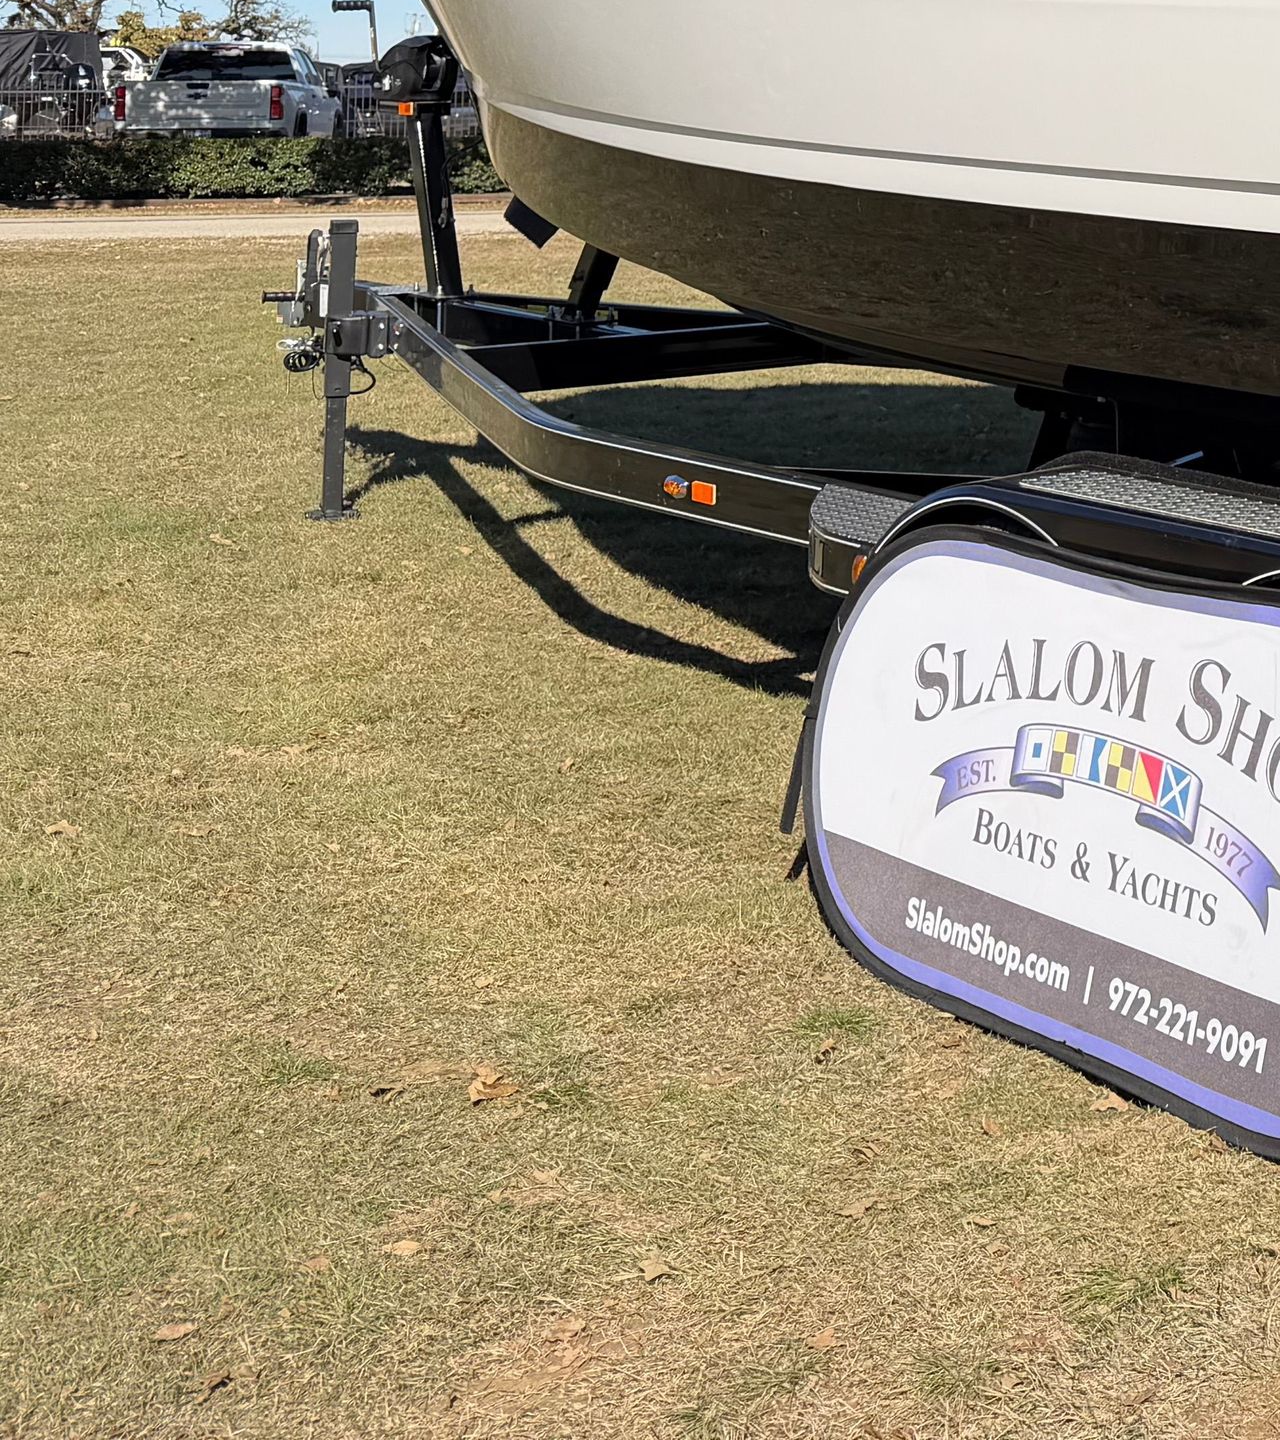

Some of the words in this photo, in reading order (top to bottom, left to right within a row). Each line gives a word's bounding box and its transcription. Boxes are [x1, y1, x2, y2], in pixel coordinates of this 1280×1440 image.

[914, 638, 1155, 723] SLALOM
[956, 759, 997, 792] EST.
[972, 808, 1057, 870] BOATS
[1071, 843, 1092, 884] &
[1107, 852, 1219, 927] YACHTS
[1203, 826, 1254, 878] 1977
[905, 897, 1070, 992] SlalomShop.com
[1108, 977, 1268, 1074] 972-221-9091
